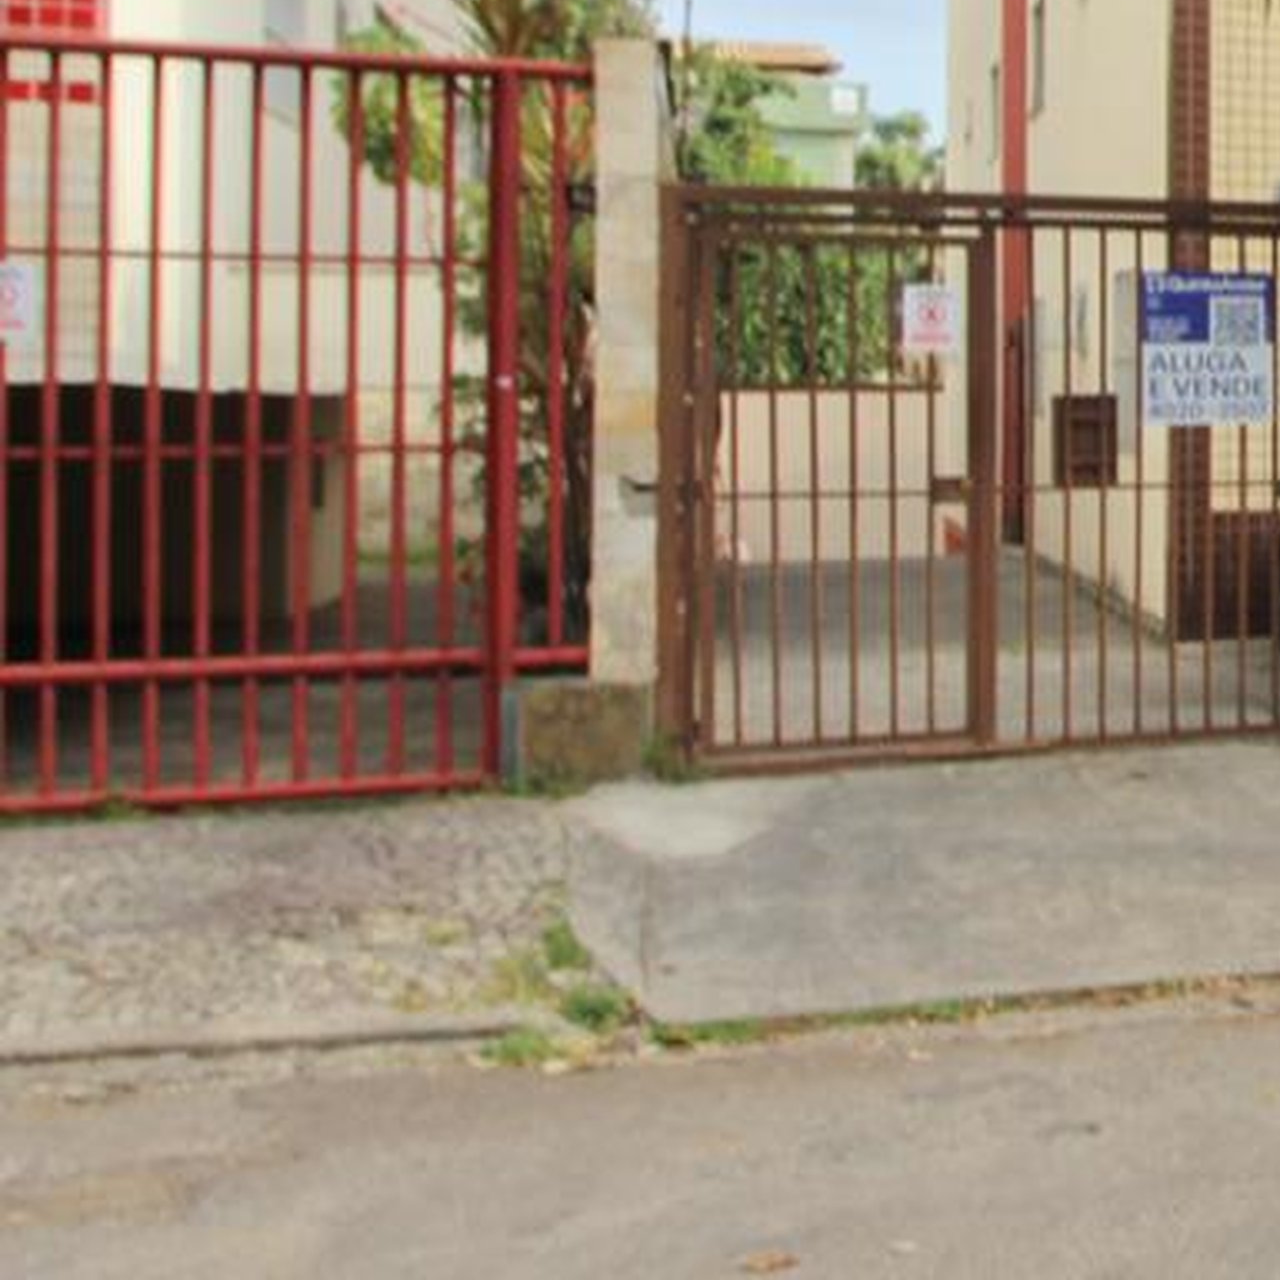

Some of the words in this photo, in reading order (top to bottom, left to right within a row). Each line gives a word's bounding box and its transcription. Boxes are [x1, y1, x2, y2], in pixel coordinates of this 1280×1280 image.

[1150, 352, 1249, 373] ALUGA
[1149, 377, 1163, 399] E
[1172, 376, 1268, 398] VENDE
